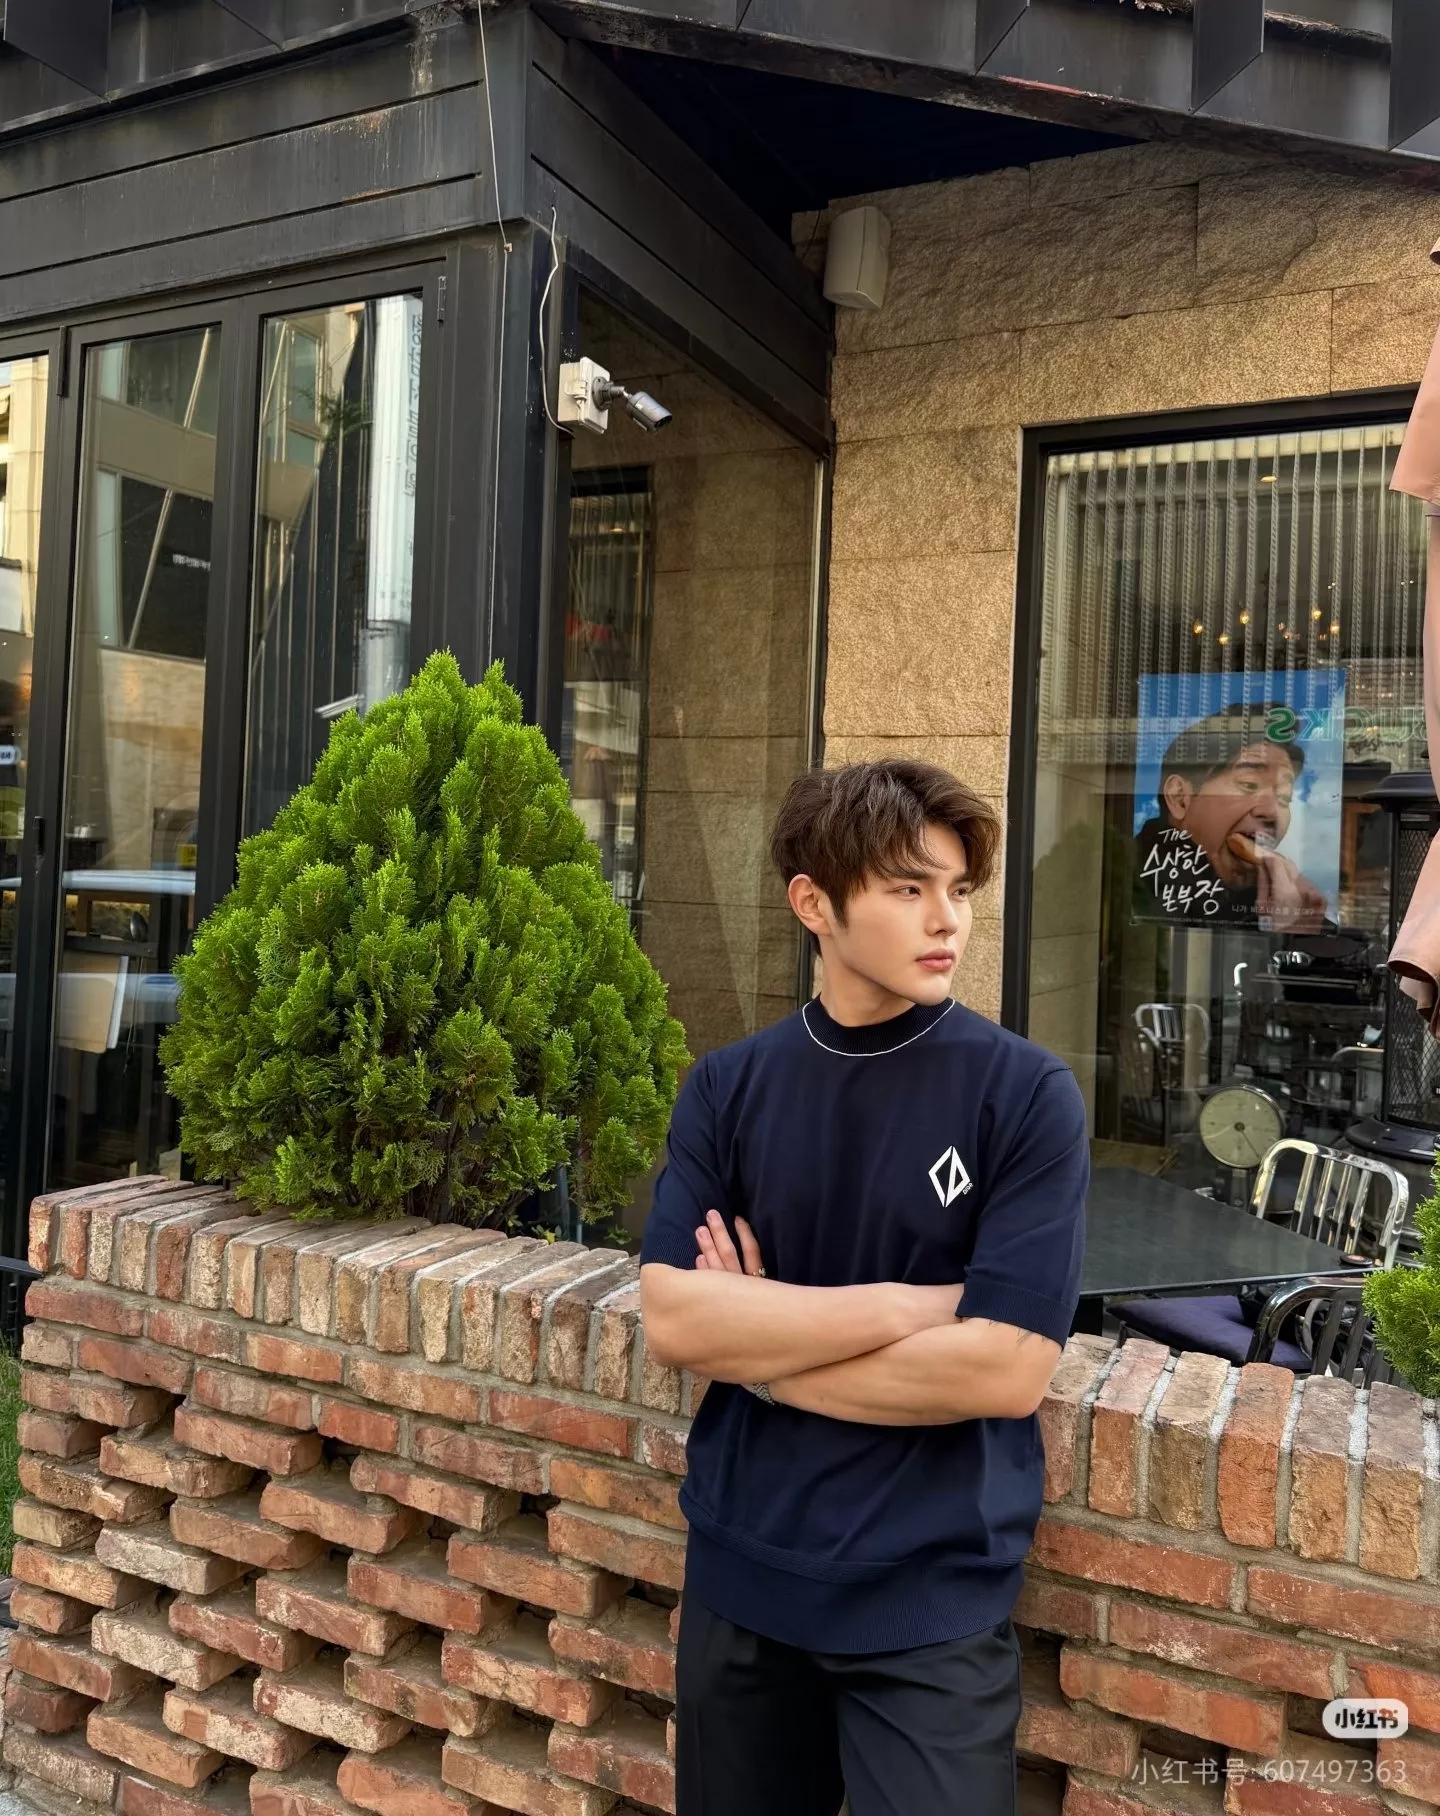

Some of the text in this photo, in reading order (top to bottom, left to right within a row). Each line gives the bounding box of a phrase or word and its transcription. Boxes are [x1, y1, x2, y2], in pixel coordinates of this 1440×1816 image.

[1158, 828, 1193, 843] The
[1140, 843, 1210, 897] 수상한
[1162, 878, 1224, 915] 본부장
